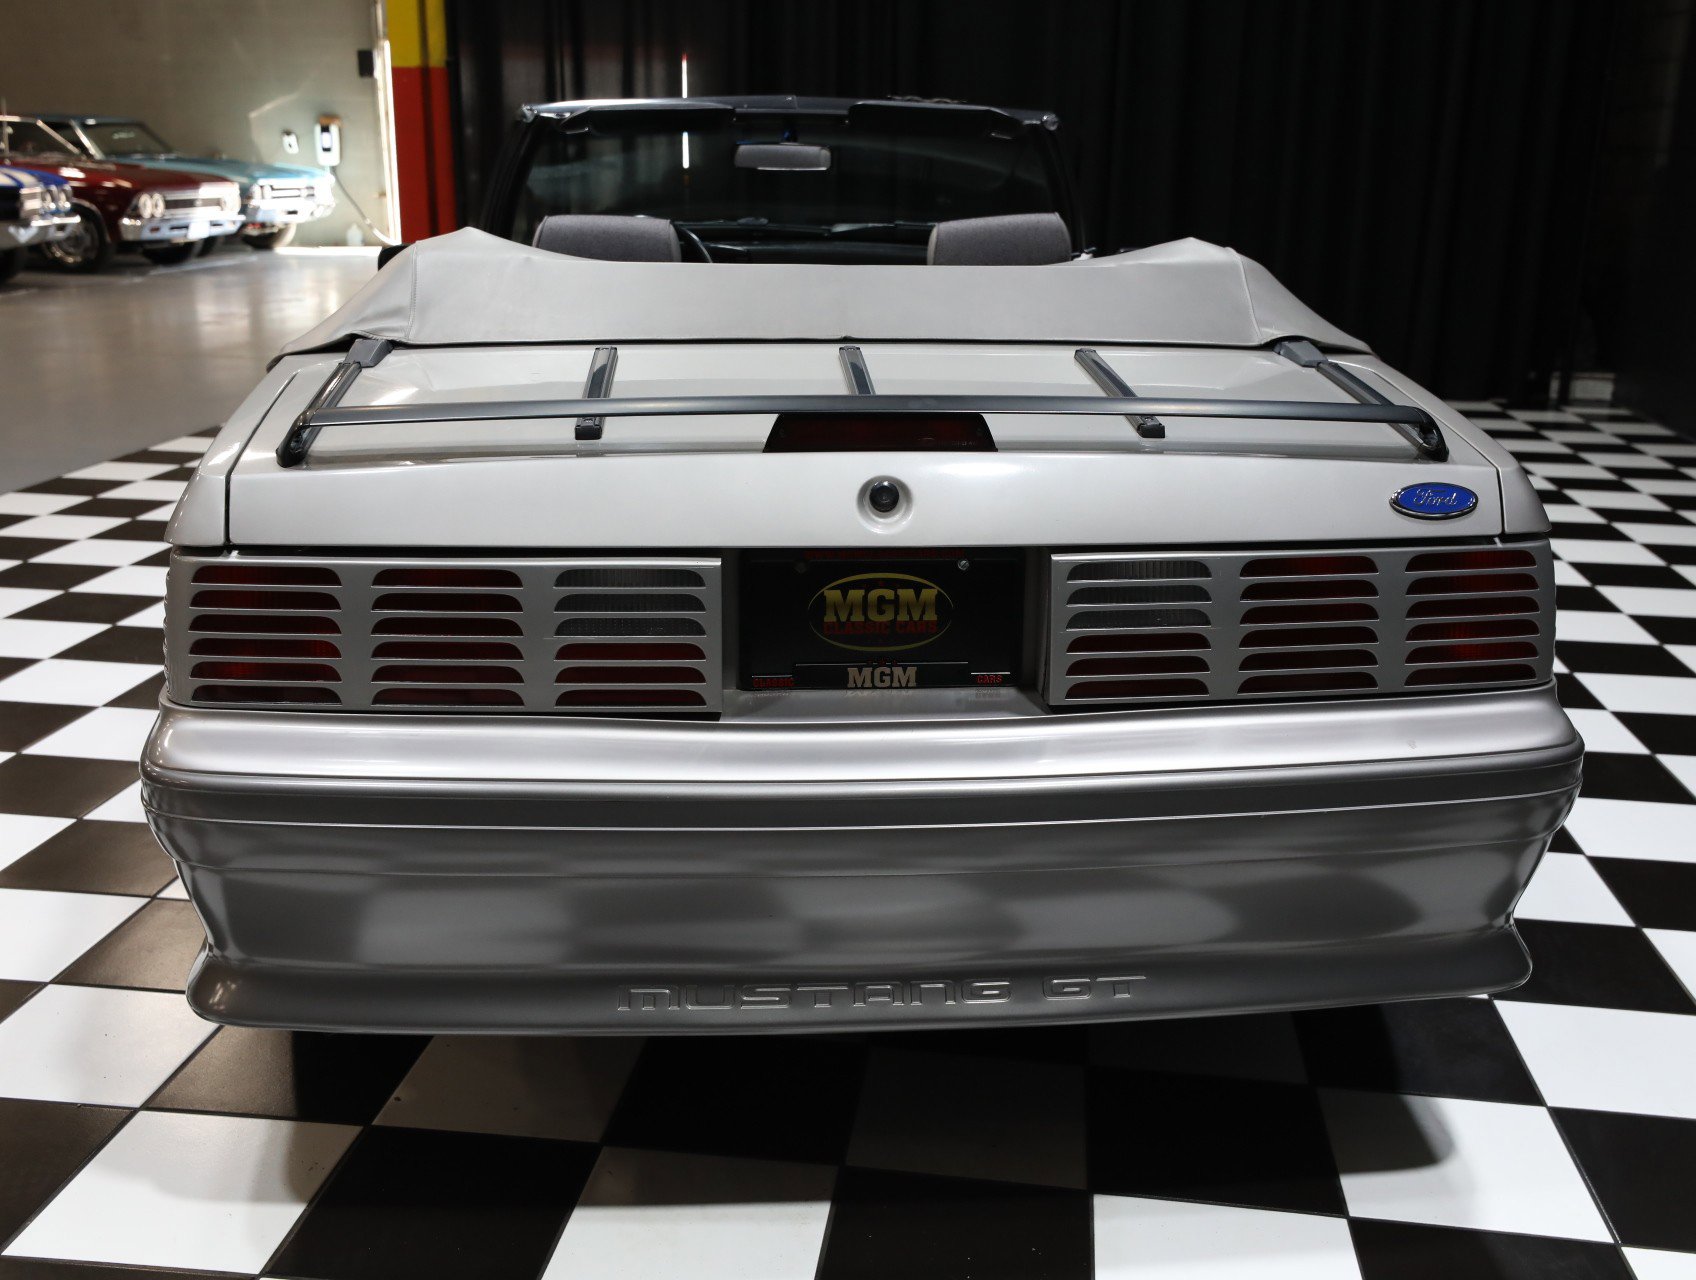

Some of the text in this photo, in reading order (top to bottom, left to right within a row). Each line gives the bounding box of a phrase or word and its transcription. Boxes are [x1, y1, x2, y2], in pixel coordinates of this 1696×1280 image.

[1413, 488, 1458, 506] Ford
[823, 588, 939, 622] MGM
[823, 621, 937, 635] CLASSIC CARS
[847, 666, 917, 688] MGM
[976, 675, 1004, 685] CARS
[617, 975, 1147, 1011] MUSTANG GT
